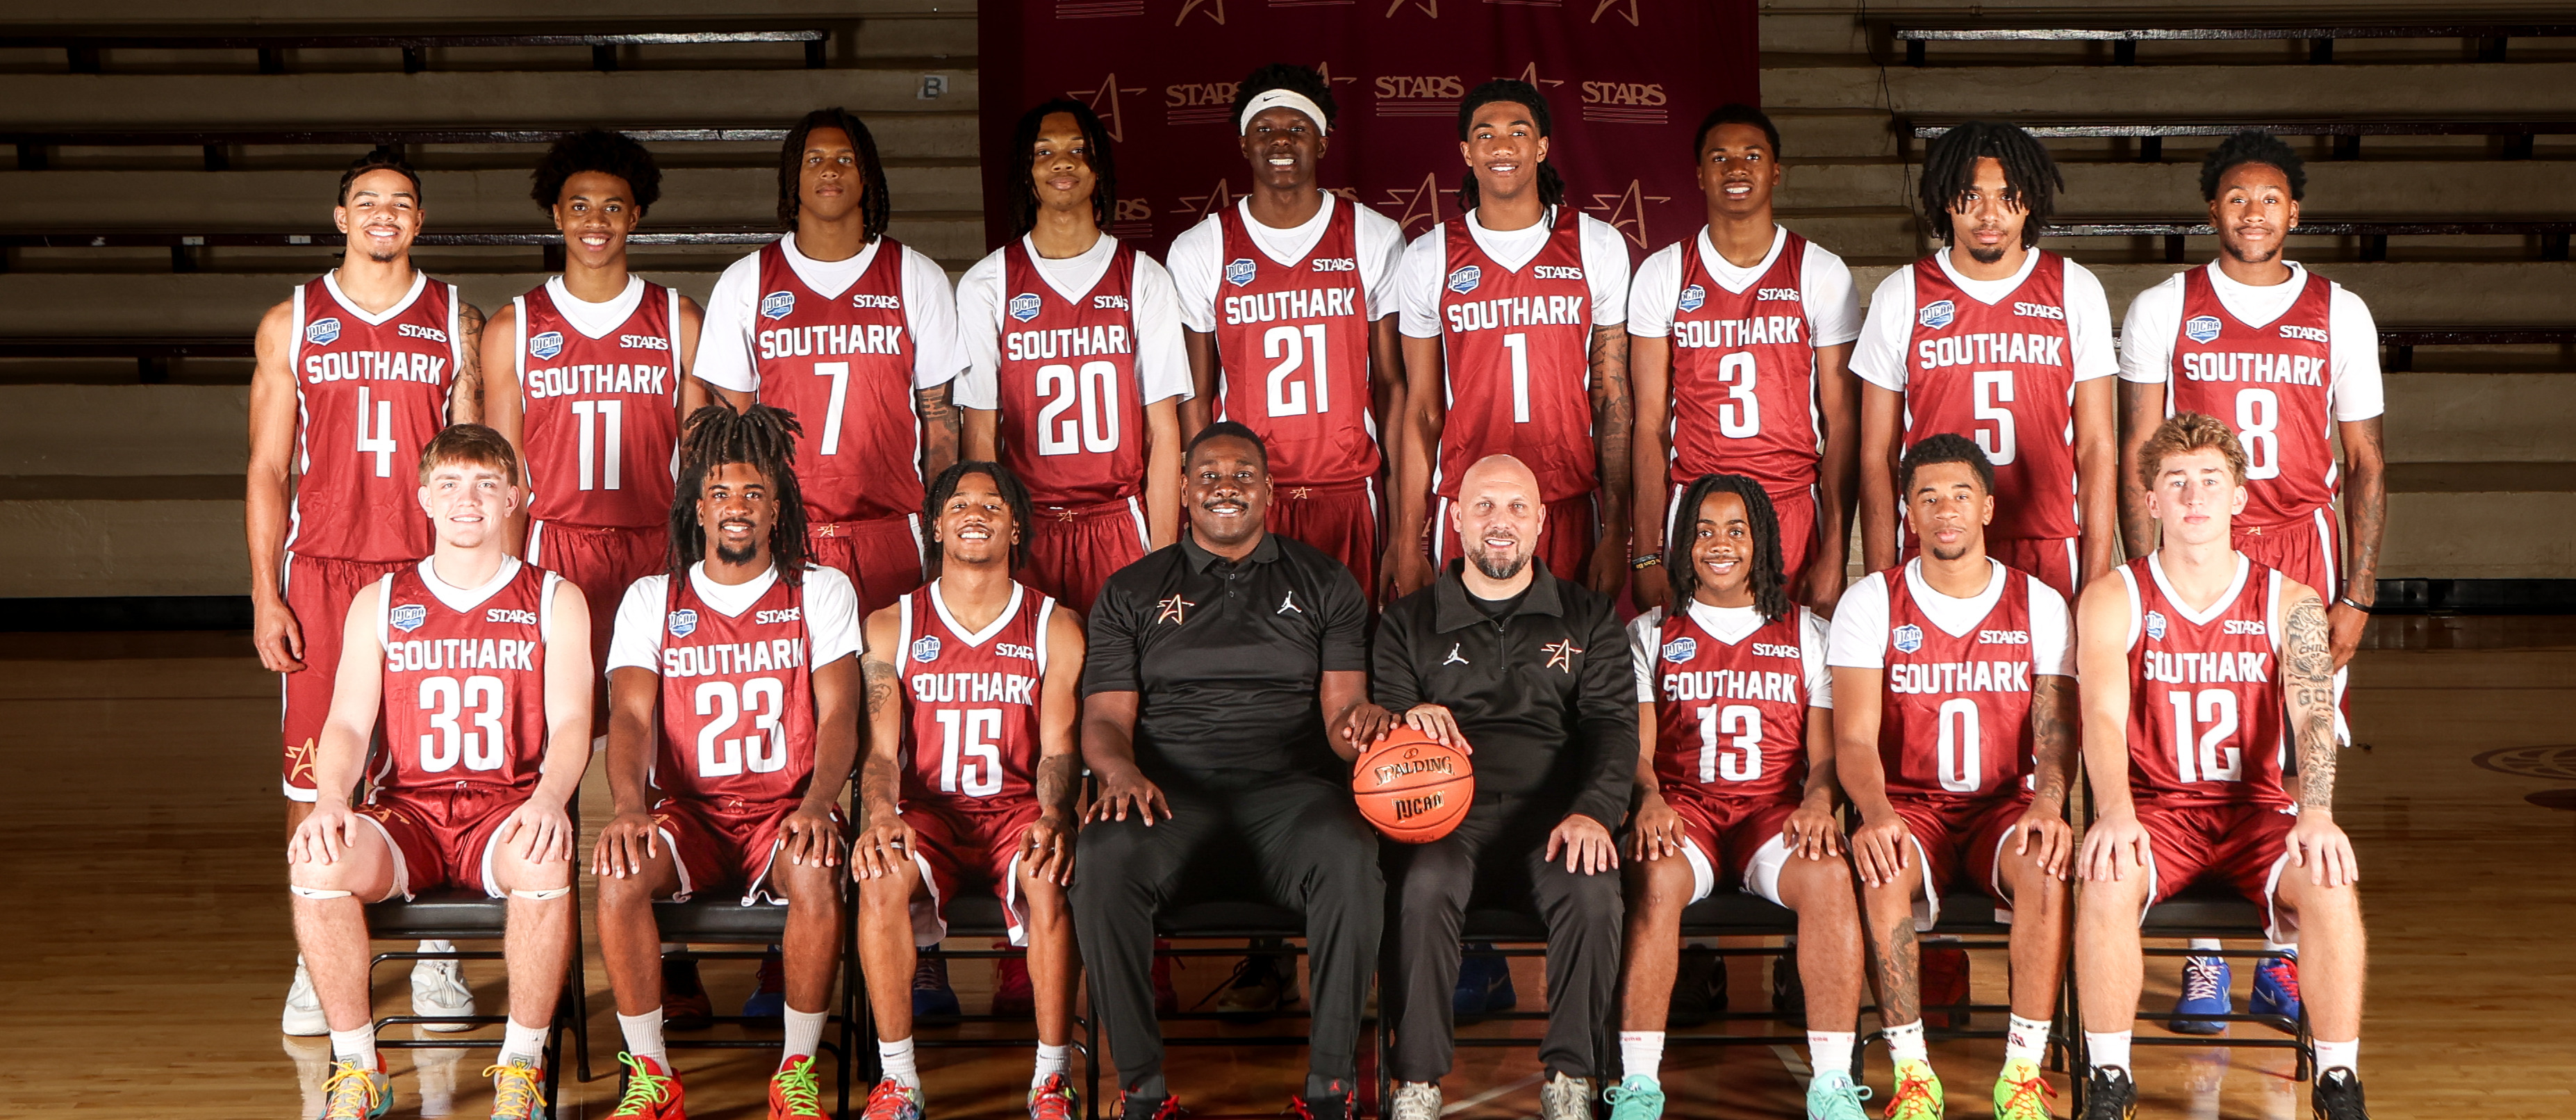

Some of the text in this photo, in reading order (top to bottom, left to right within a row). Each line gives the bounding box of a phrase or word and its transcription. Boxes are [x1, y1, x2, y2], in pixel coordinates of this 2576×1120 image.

[923, 77, 941, 98] B
[1166, 81, 1241, 107] STAR
[1375, 76, 1464, 99] STARS
[1581, 81, 1667, 106] STARS
[1227, 263, 1255, 278] NJCAA
[1312, 258, 1355, 272] STARS
[1450, 270, 1480, 286] NJCAA
[1534, 265, 1583, 279] STARS
[763, 296, 793, 313] NJCAA
[853, 295, 900, 308] STARS
[1012, 299, 1039, 313] NJCAA
[1225, 288, 1355, 325] SOUTHARK
[1757, 288, 1799, 302] STARS
[1447, 296, 1583, 332] SOUTHARK
[1922, 304, 1953, 320] NJCAA
[2013, 302, 2064, 320] STARS
[308, 322, 339, 338] NJCAA
[398, 324, 447, 343] STARS
[620, 335, 668, 349] STARS
[760, 324, 902, 359] SOUTHARK
[1674, 316, 1801, 348] SOUTHARK
[2188, 322, 2220, 333] NJCAA
[2279, 326, 2327, 342] STARS
[531, 337, 562, 352] NJCAA
[1919, 333, 2063, 369] SOUTHARK
[306, 351, 445, 385] SOUTHARK
[528, 364, 668, 398] SOUTHARK
[1263, 324, 1329, 418] 21
[1503, 333, 1530, 423] 1
[2183, 352, 2325, 386] SOUTHARK
[814, 361, 849, 455] 7
[1035, 361, 1119, 456] 20
[1718, 351, 1760, 438] 3
[357, 386, 397, 477] 4
[1973, 370, 2015, 466] 5
[2235, 388, 2280, 479] 8
[572, 400, 621, 491] 11
[392, 609, 424, 622] NJCAA
[486, 609, 537, 625] STARS
[2223, 620, 2265, 635] STARS
[1665, 641, 1694, 657] NJCAA
[1752, 643, 1800, 659] STARS
[1979, 630, 2029, 644] STARS
[388, 639, 536, 672] SOUTHARK
[663, 637, 804, 677] SOUTHARK
[1663, 669, 1797, 704] SOUTHARK
[1890, 661, 2029, 694] SOUTHARK
[419, 675, 504, 773] 33
[695, 677, 787, 777] 23
[2169, 689, 2242, 784] 12
[936, 709, 1003, 797] 15
[1696, 703, 1762, 783] 13
[1938, 698, 1981, 792] 0
[1375, 756, 1453, 786] SPALDING
[1393, 792, 1444, 823] NJCAA
